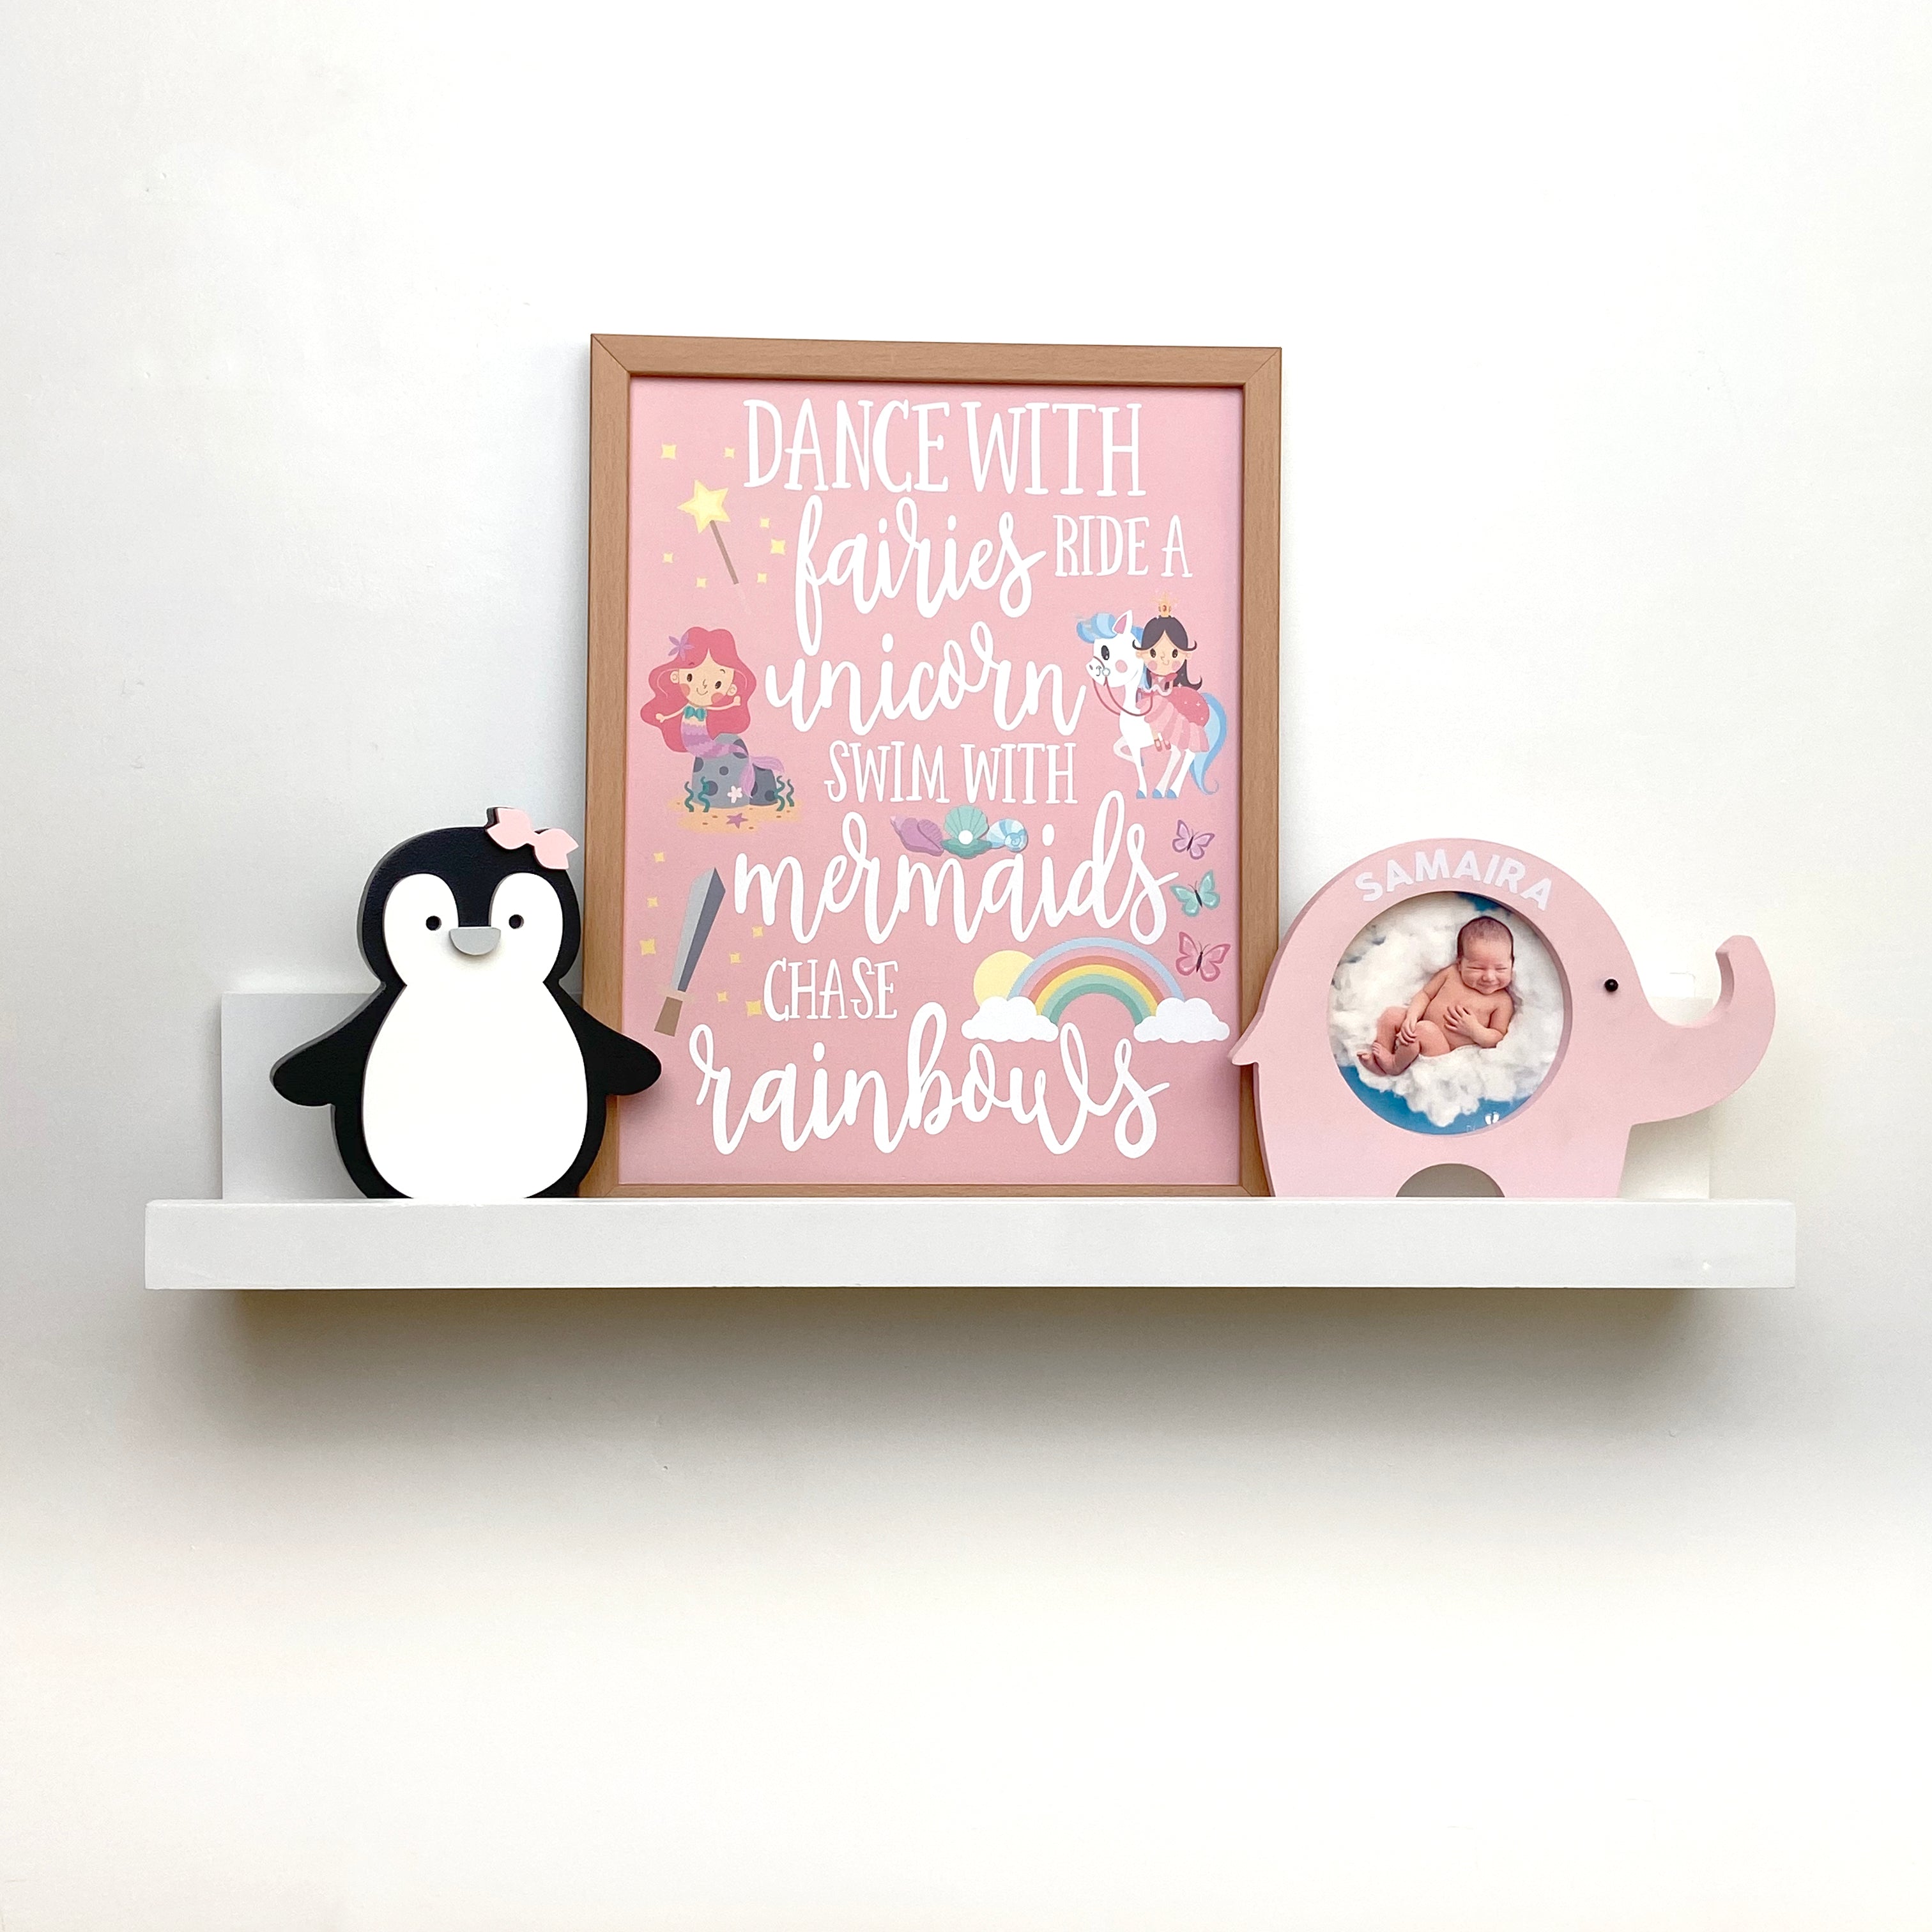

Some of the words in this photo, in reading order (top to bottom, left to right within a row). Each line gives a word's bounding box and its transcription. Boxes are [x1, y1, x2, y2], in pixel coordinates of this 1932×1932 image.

[742, 397, 950, 493] DANCE
[960, 401, 1147, 497] WITH
[795, 494, 1047, 657] fairies
[1052, 514, 1150, 577] RIDE
[1160, 514, 1193, 578] A
[765, 620, 1087, 736] unicorn
[824, 740, 951, 804] SWIM
[960, 742, 1078, 804] WITH
[734, 790, 1179, 945] mermaids
[1354, 848, 1553, 911] SAMAIRA
[763, 956, 898, 1022] CHASE
[689, 1002, 1170, 1159] rainbows
